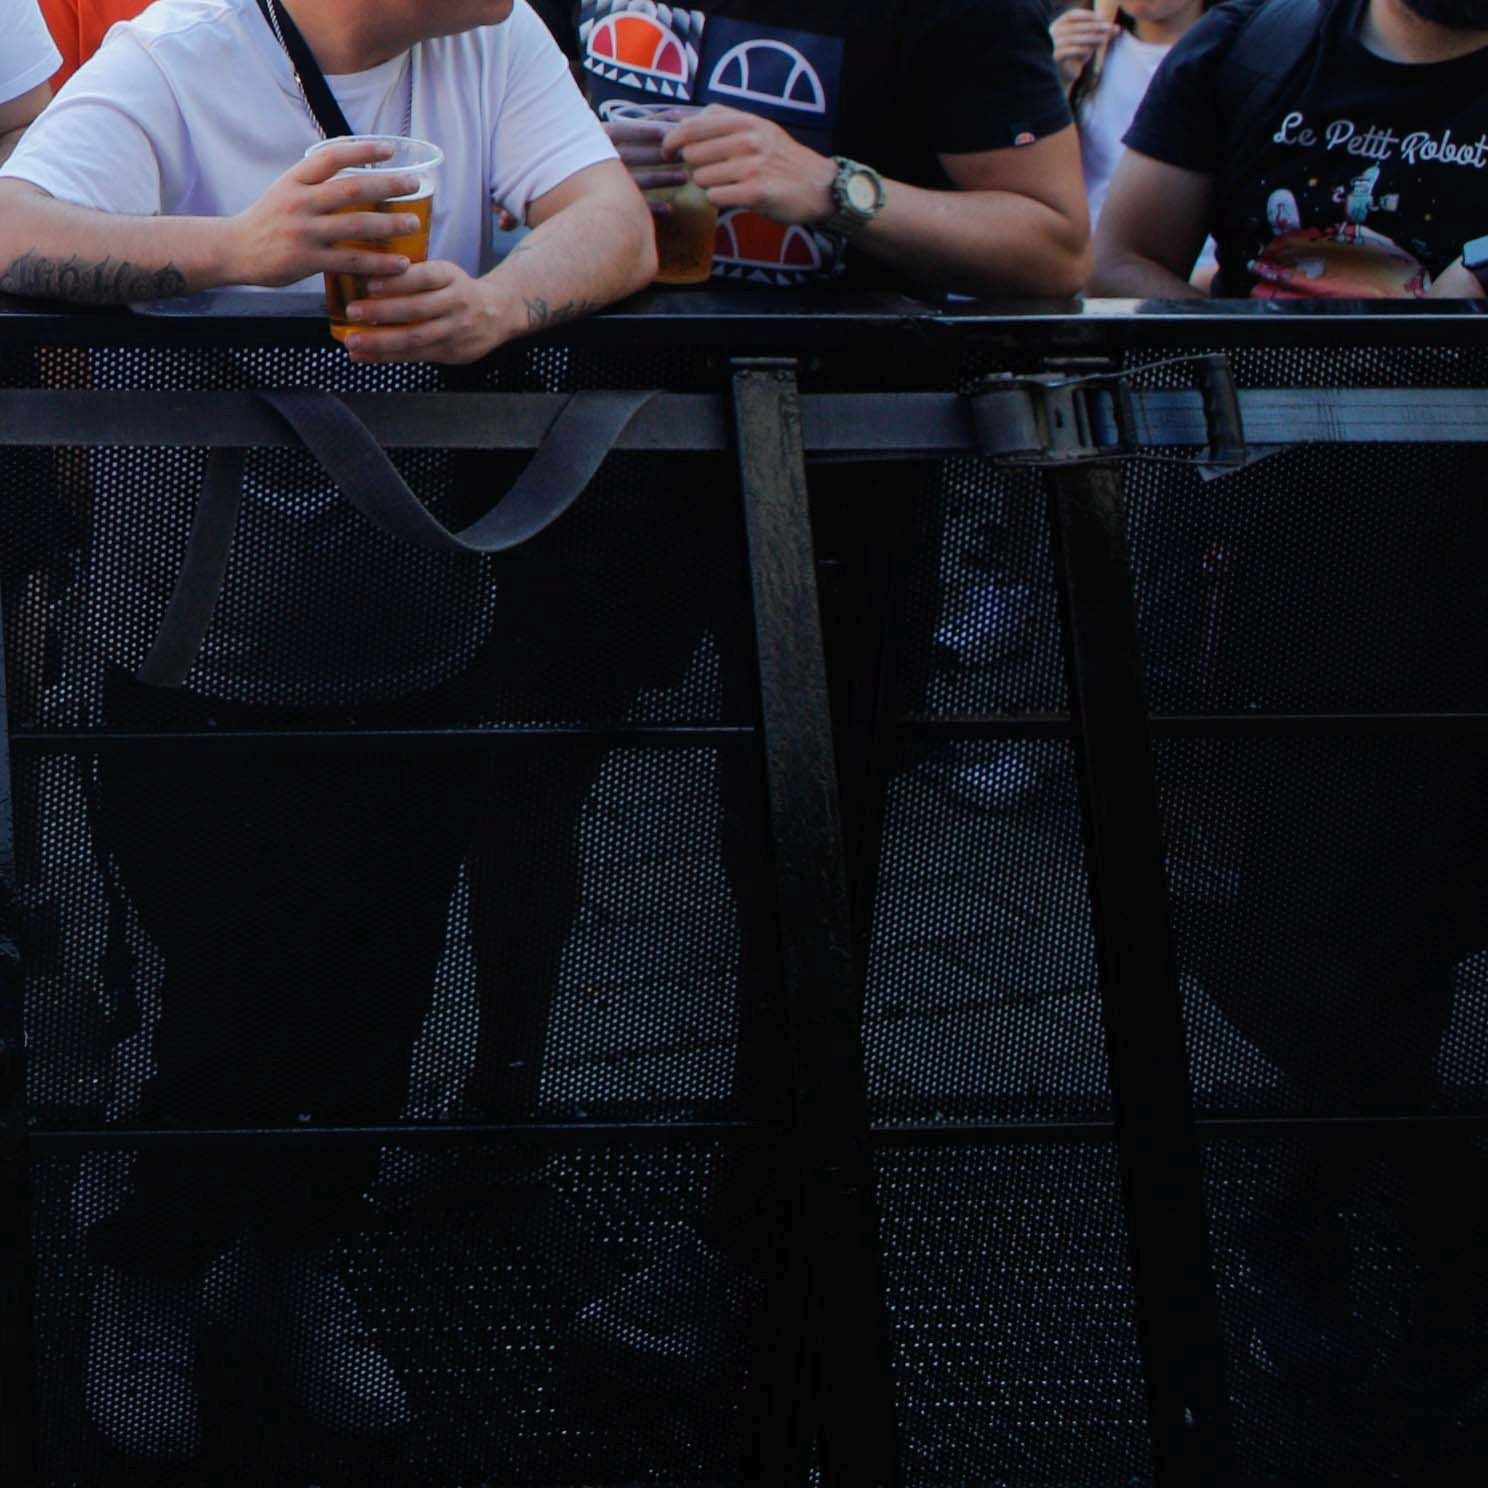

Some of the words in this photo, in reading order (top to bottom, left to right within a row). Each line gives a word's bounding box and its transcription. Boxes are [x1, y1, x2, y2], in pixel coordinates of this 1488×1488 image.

[1273, 111, 1317, 147] Le
[1326, 119, 1399, 161] Petit
[1401, 129, 1488, 169] Robot
